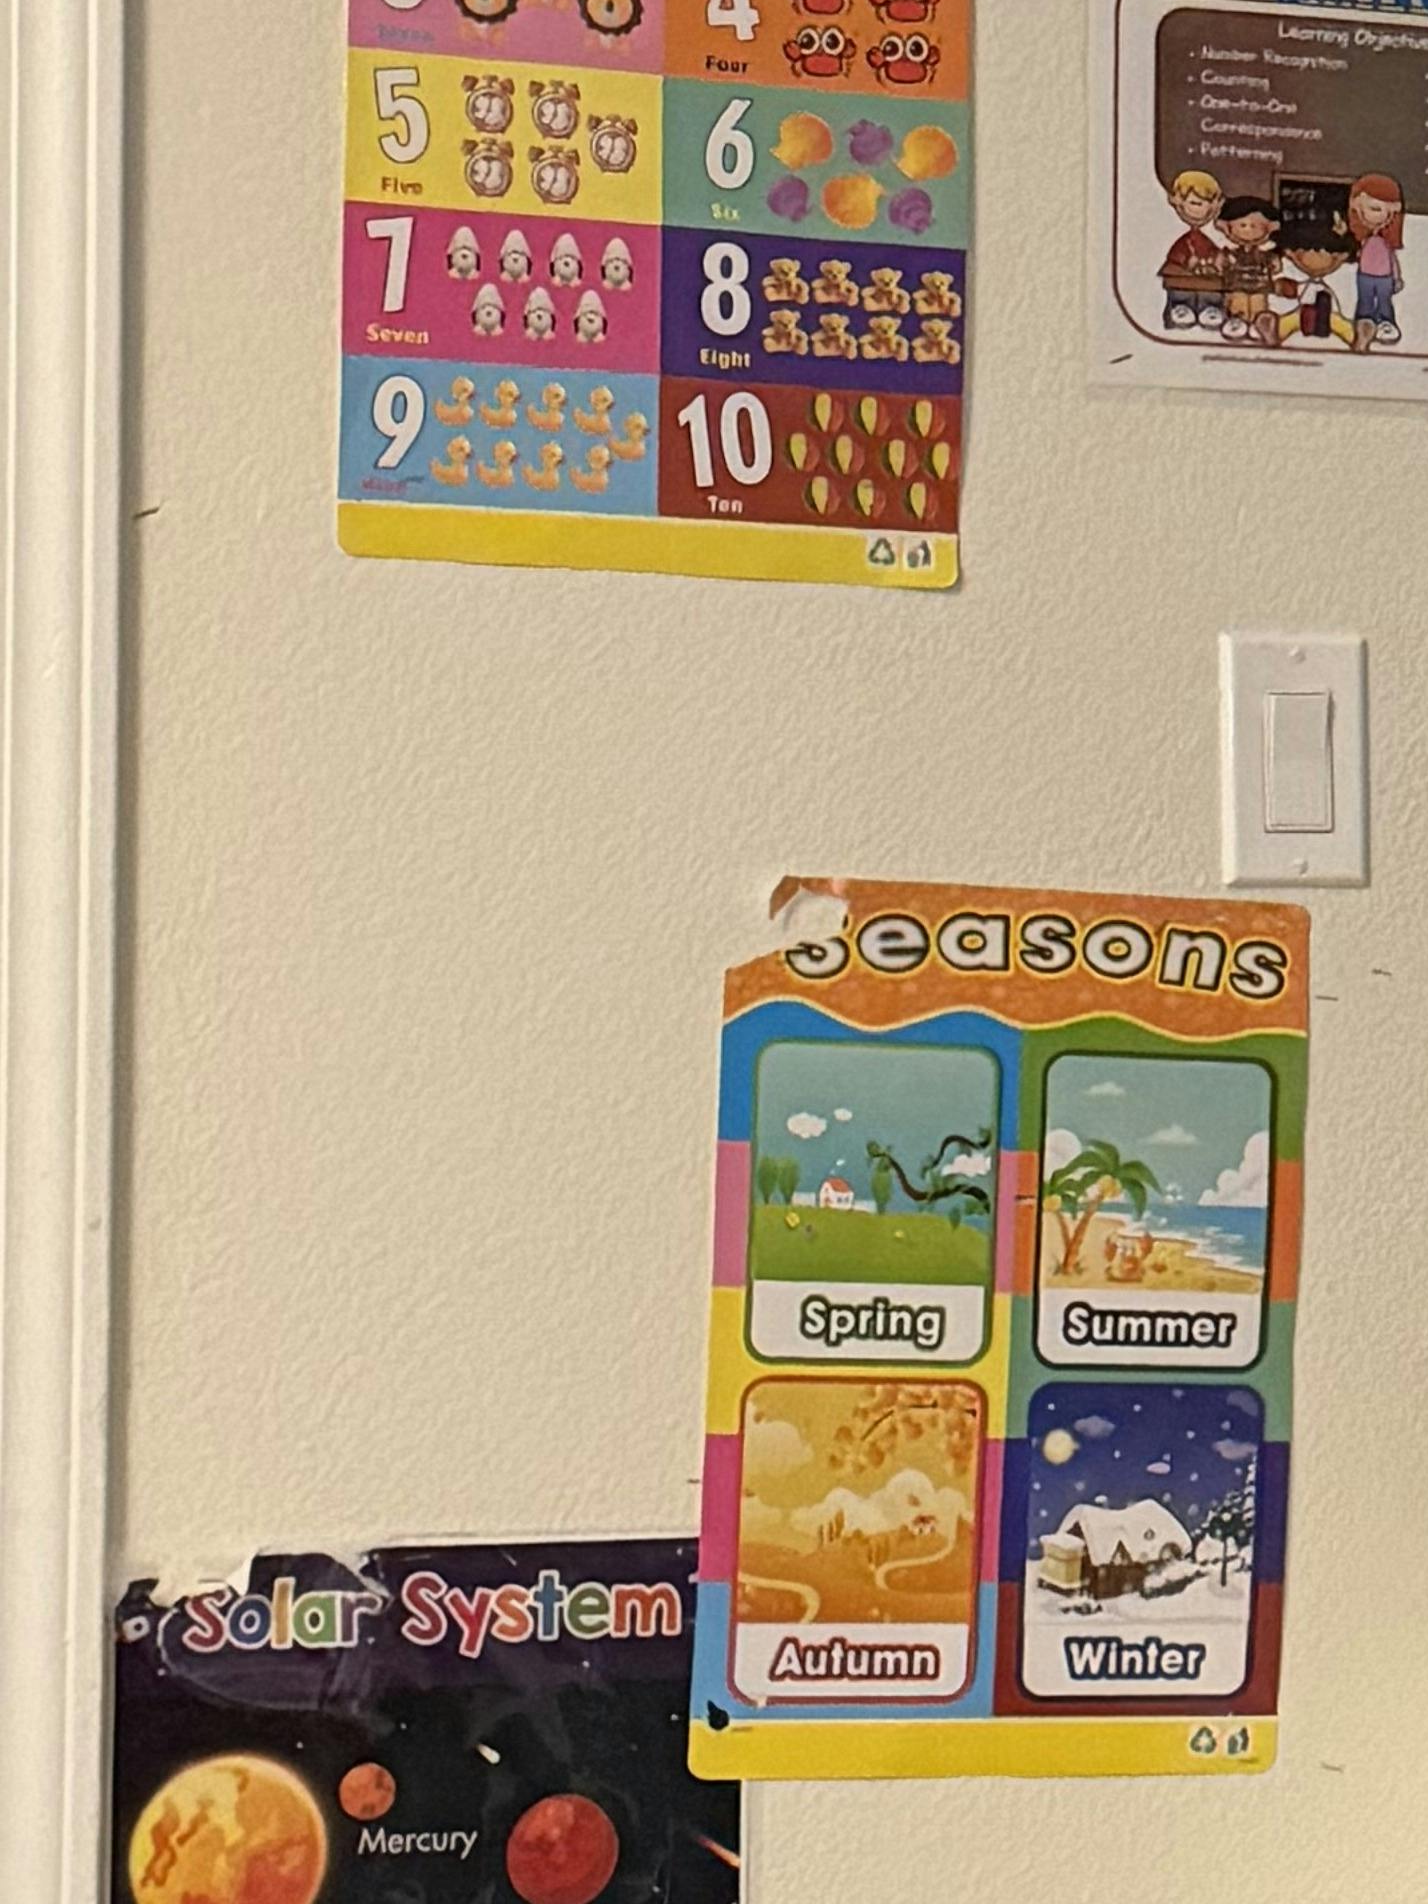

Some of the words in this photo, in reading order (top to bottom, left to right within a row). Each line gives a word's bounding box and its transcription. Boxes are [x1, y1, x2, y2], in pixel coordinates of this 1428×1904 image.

[1277, 20, 1350, 48] Learning
[705, 55, 750, 74] Four
[374, 66, 431, 164] 5
[705, 97, 754, 190] 6
[381, 177, 423, 195] Five
[711, 202, 741, 221] Six
[365, 216, 415, 313] 7
[701, 242, 751, 336] 8
[365, 323, 430, 345] Seven
[699, 348, 751, 370] Eight
[372, 374, 426, 469] 9
[677, 391, 773, 488] 10
[707, 495, 743, 514] Ten
[801, 1295, 944, 1352] Spring
[1063, 1301, 1236, 1348] Summer
[181, 1576, 383, 1654] Solar
[401, 1569, 682, 1659] System
[768, 1636, 941, 1682] Autumn
[1064, 1636, 1206, 1681] Winter
[357, 1827, 478, 1859] Mercury
